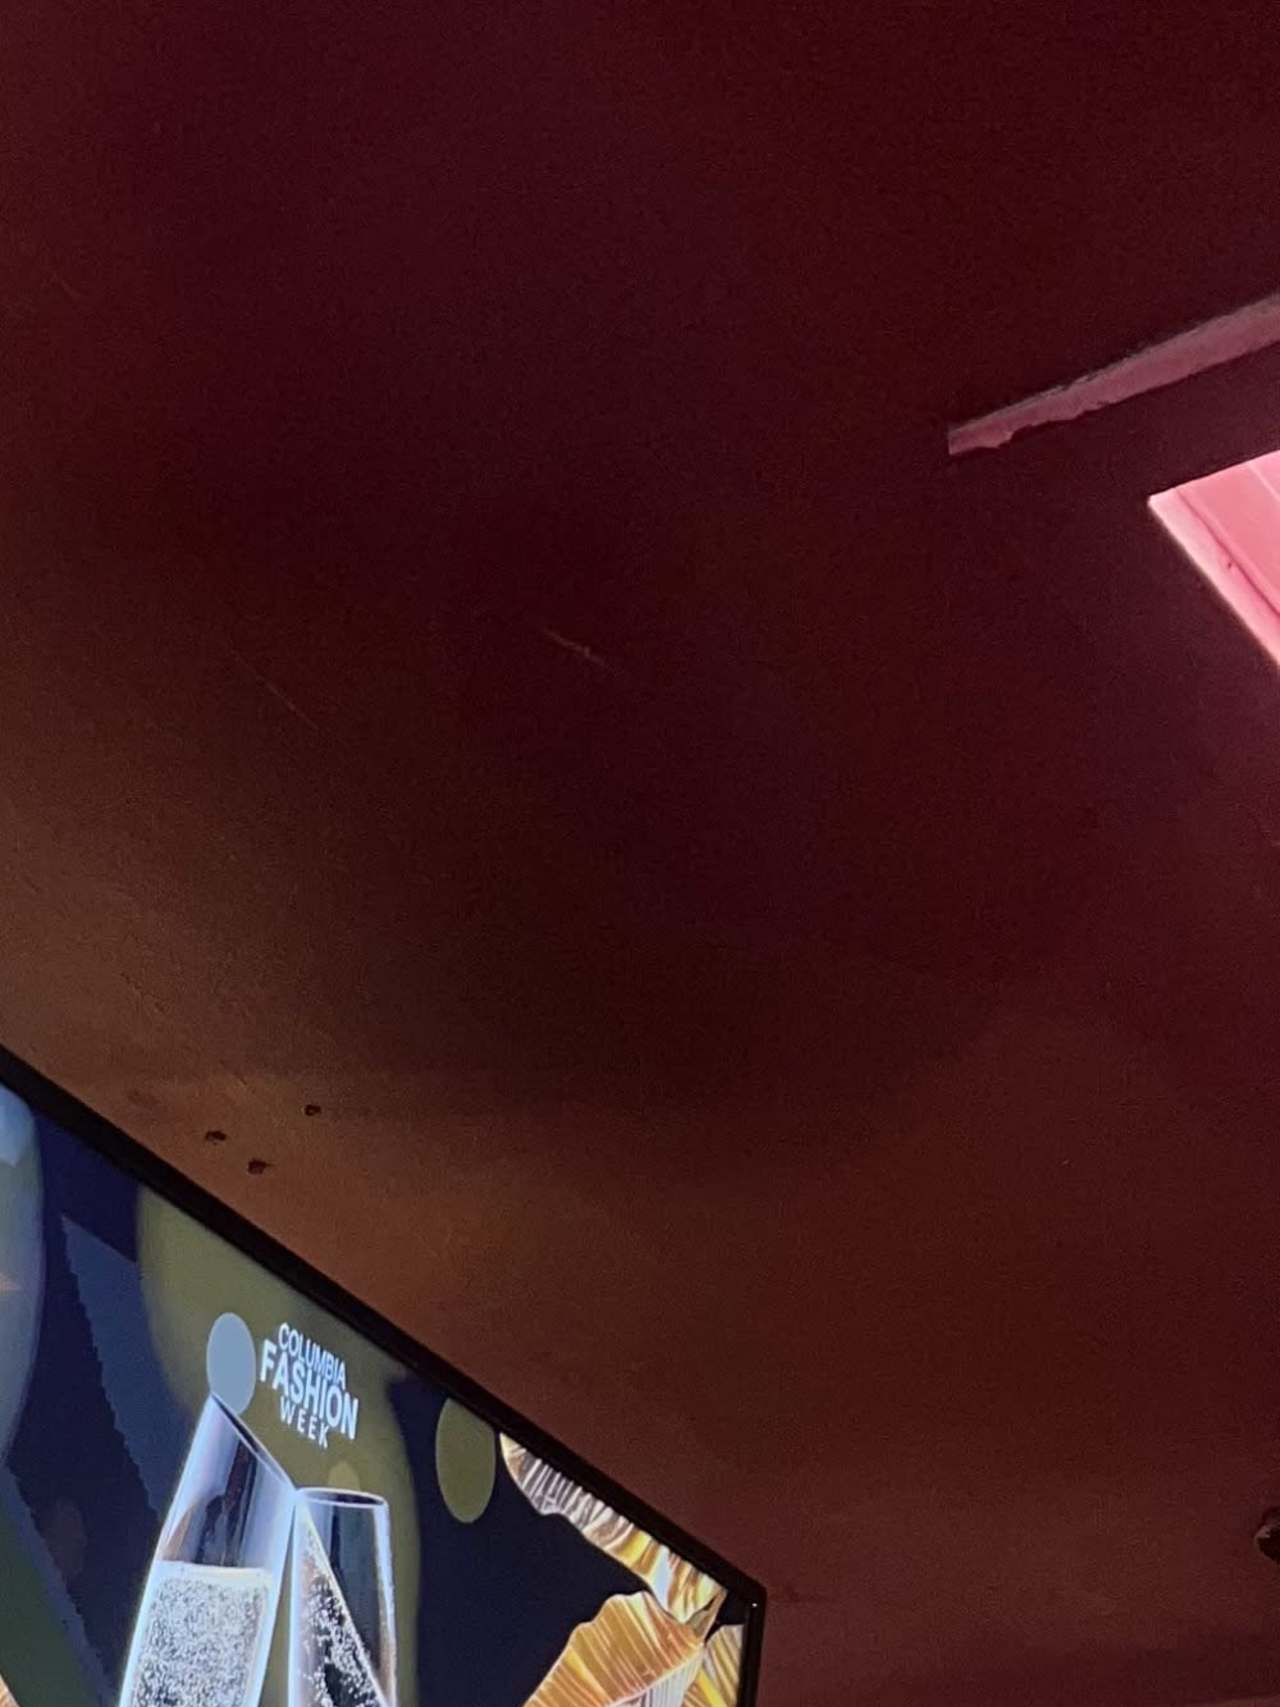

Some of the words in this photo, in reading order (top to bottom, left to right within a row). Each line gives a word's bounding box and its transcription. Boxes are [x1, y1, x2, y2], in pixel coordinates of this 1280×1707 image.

[260, 1339, 359, 1440] FASHION
[278, 1322, 346, 1390] COLUMBIA
[280, 1396, 330, 1448] WEEK
